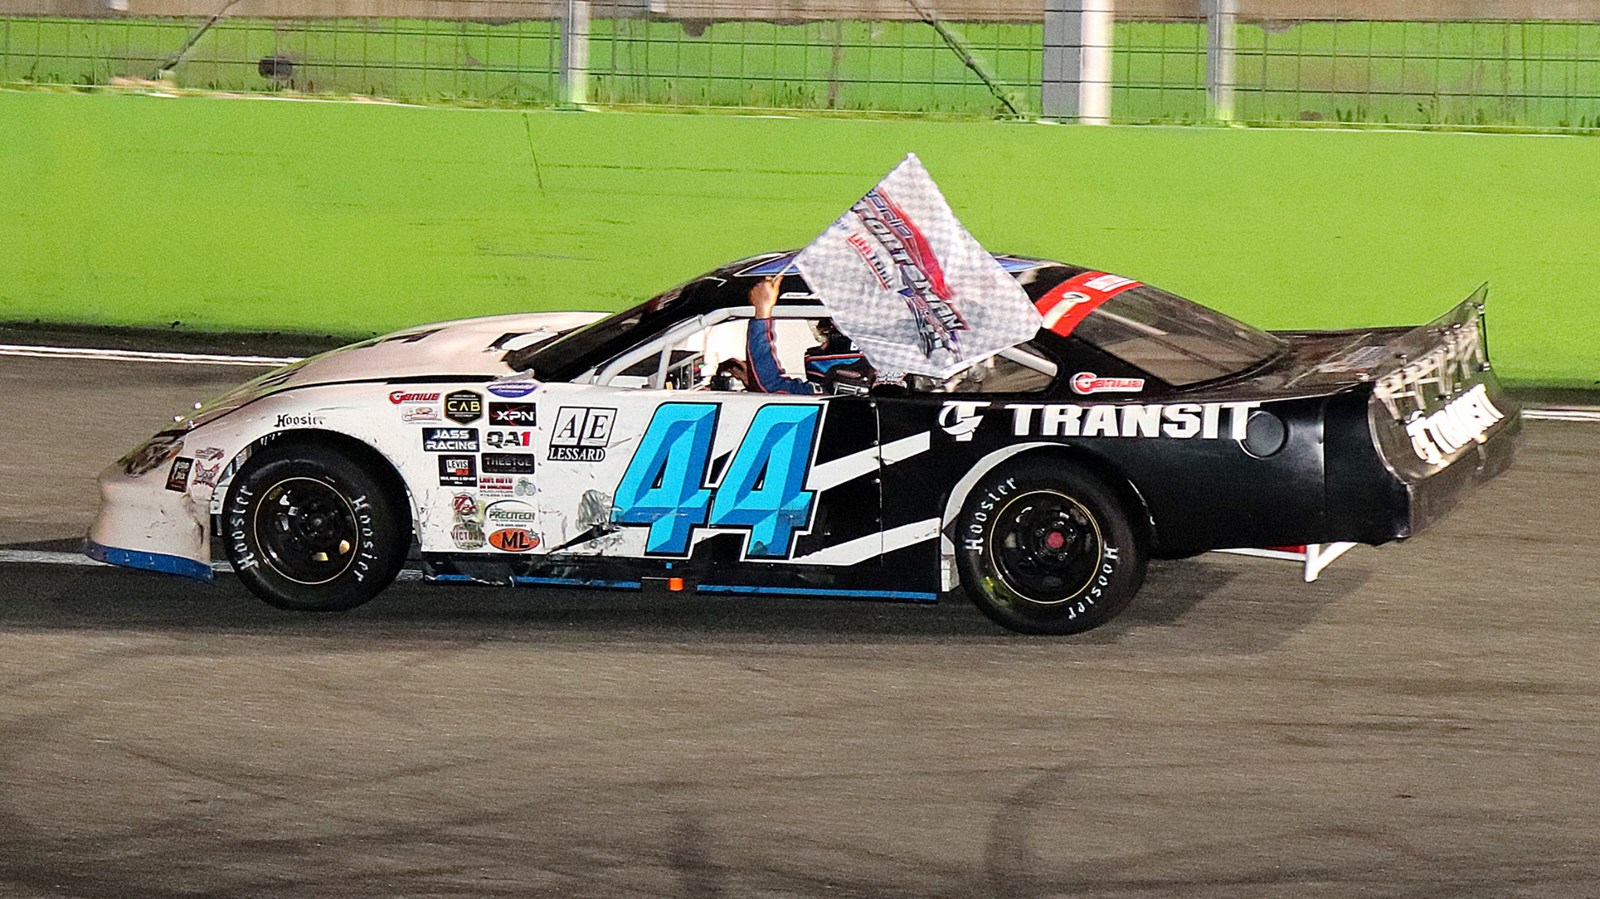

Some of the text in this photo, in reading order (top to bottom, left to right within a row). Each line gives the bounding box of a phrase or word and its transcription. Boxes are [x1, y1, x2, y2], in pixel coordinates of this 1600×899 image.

[447, 400, 480, 411] CAB
[496, 411, 535, 421] XPN
[1004, 401, 1261, 440] TRANSIT
[432, 429, 470, 440] JASS
[486, 431, 531, 449] QA1
[425, 440, 478, 451] RACING
[549, 447, 606, 461] LESSARD
[446, 460, 469, 469] LEVIS
[610, 402, 825, 559] 44
[501, 531, 530, 549] ML
